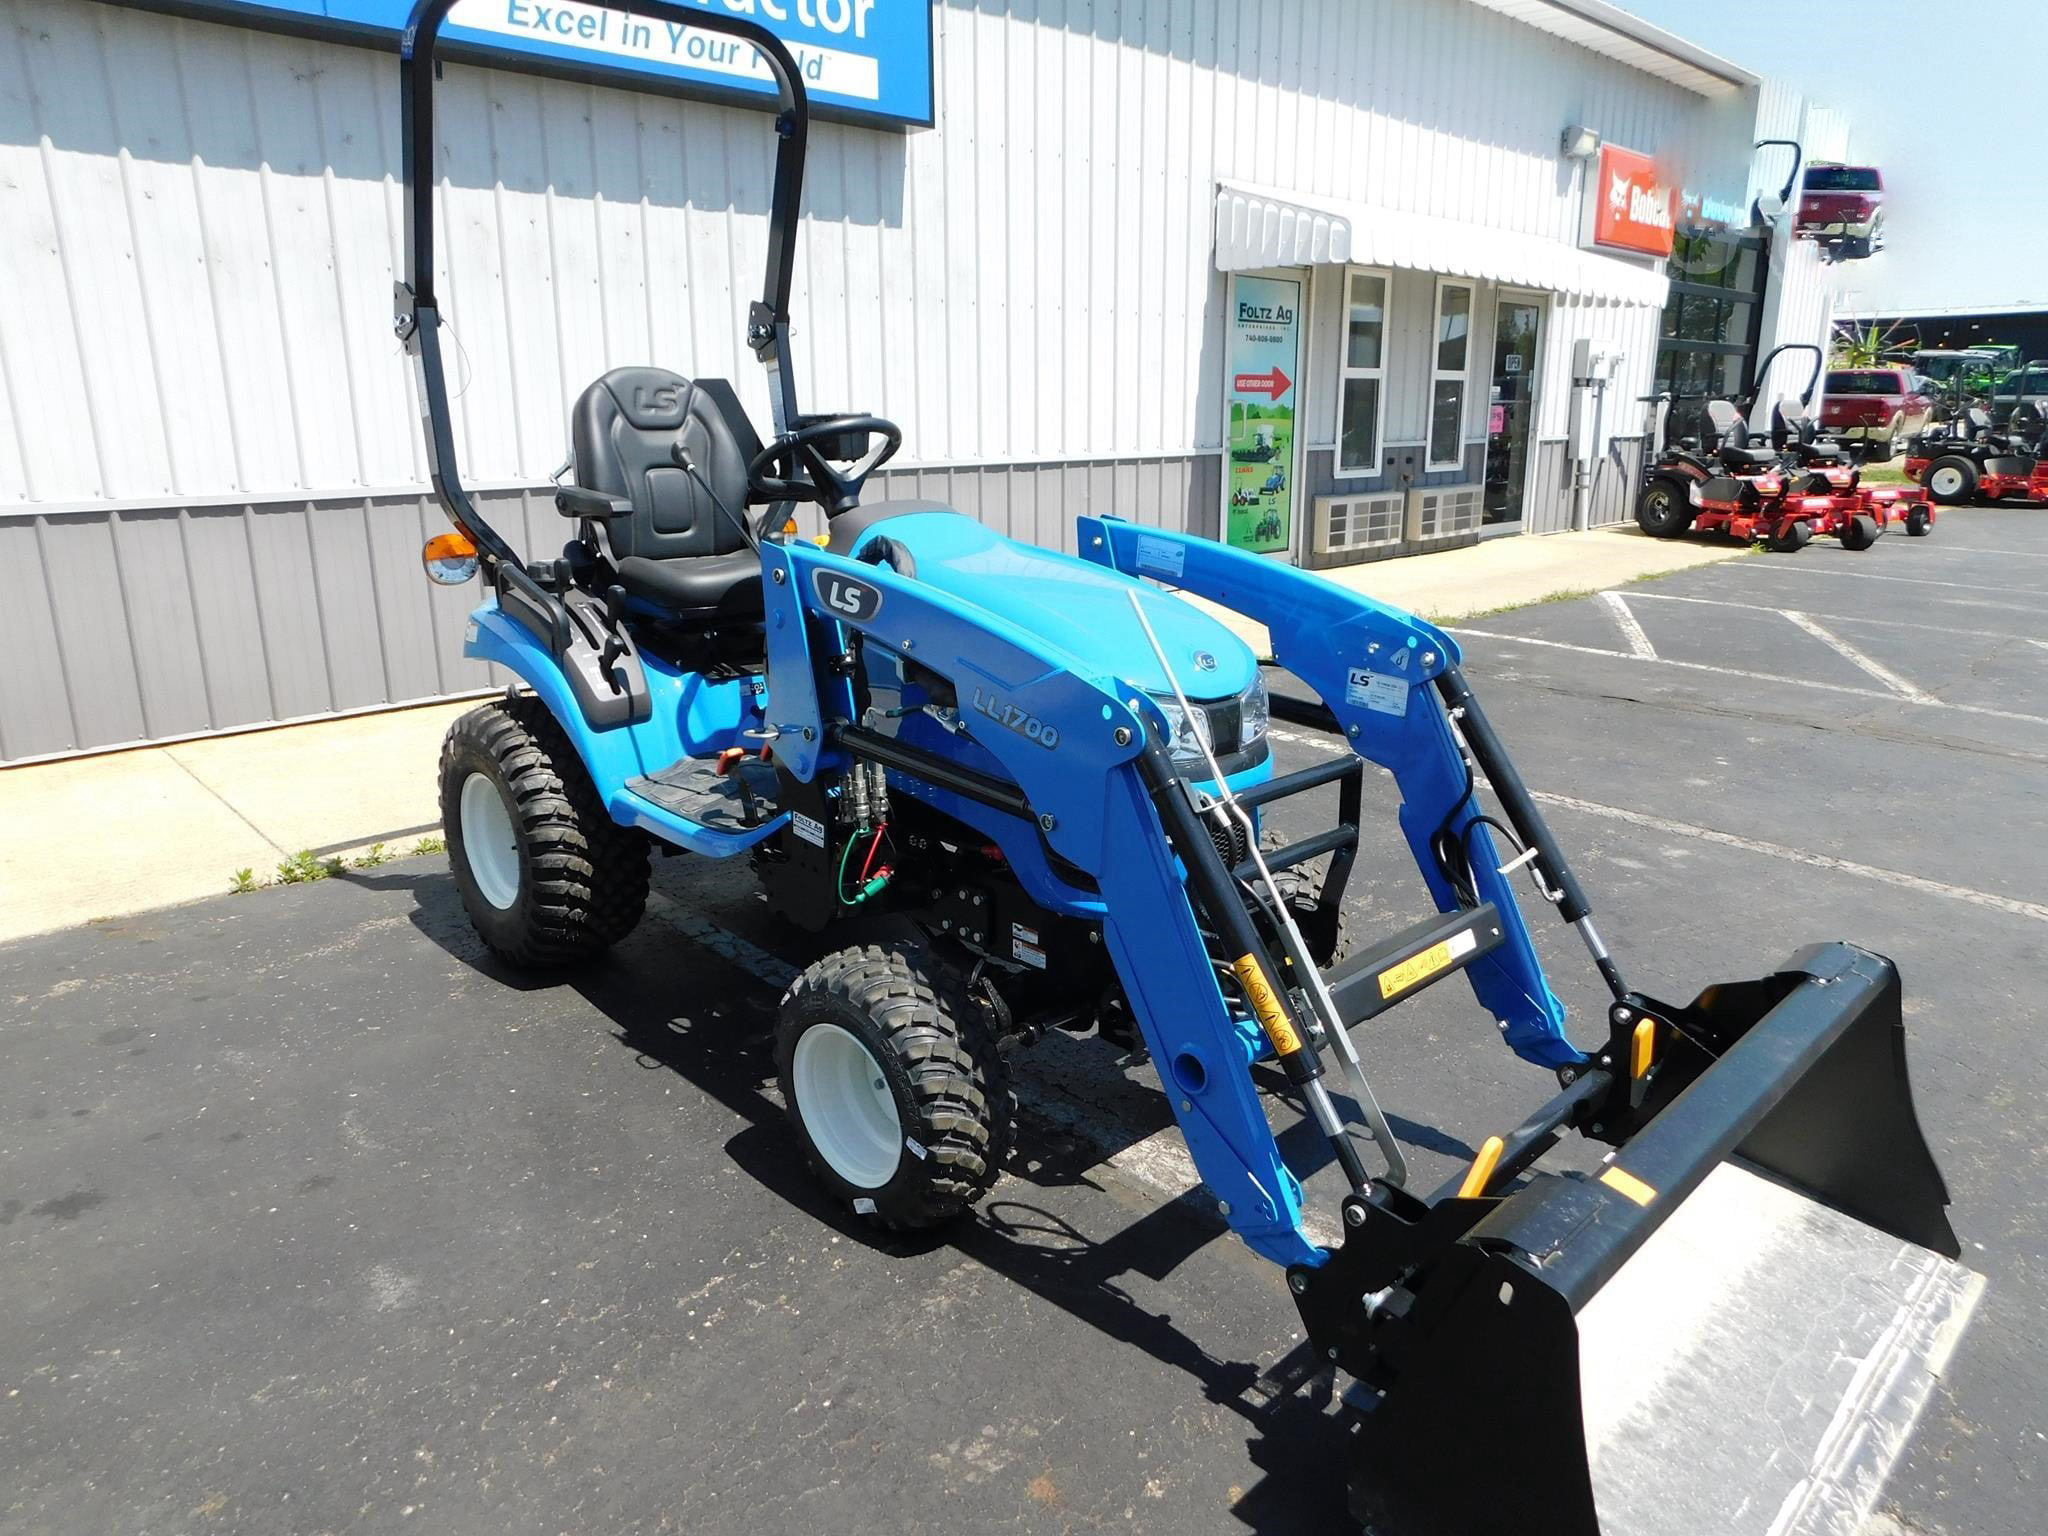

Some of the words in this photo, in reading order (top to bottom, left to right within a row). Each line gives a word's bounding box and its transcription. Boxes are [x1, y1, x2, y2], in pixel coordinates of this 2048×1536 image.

[507, 0, 608, 41] Excel
[622, 10, 651, 49] in
[665, 20, 740, 64] Your
[751, 46, 823, 80] Fld
[1276, 305, 1292, 325] Ag
[633, 387, 680, 416] LS
[829, 581, 861, 614] LS
[1350, 672, 1370, 687] LS
[973, 687, 1060, 748] LL1700
